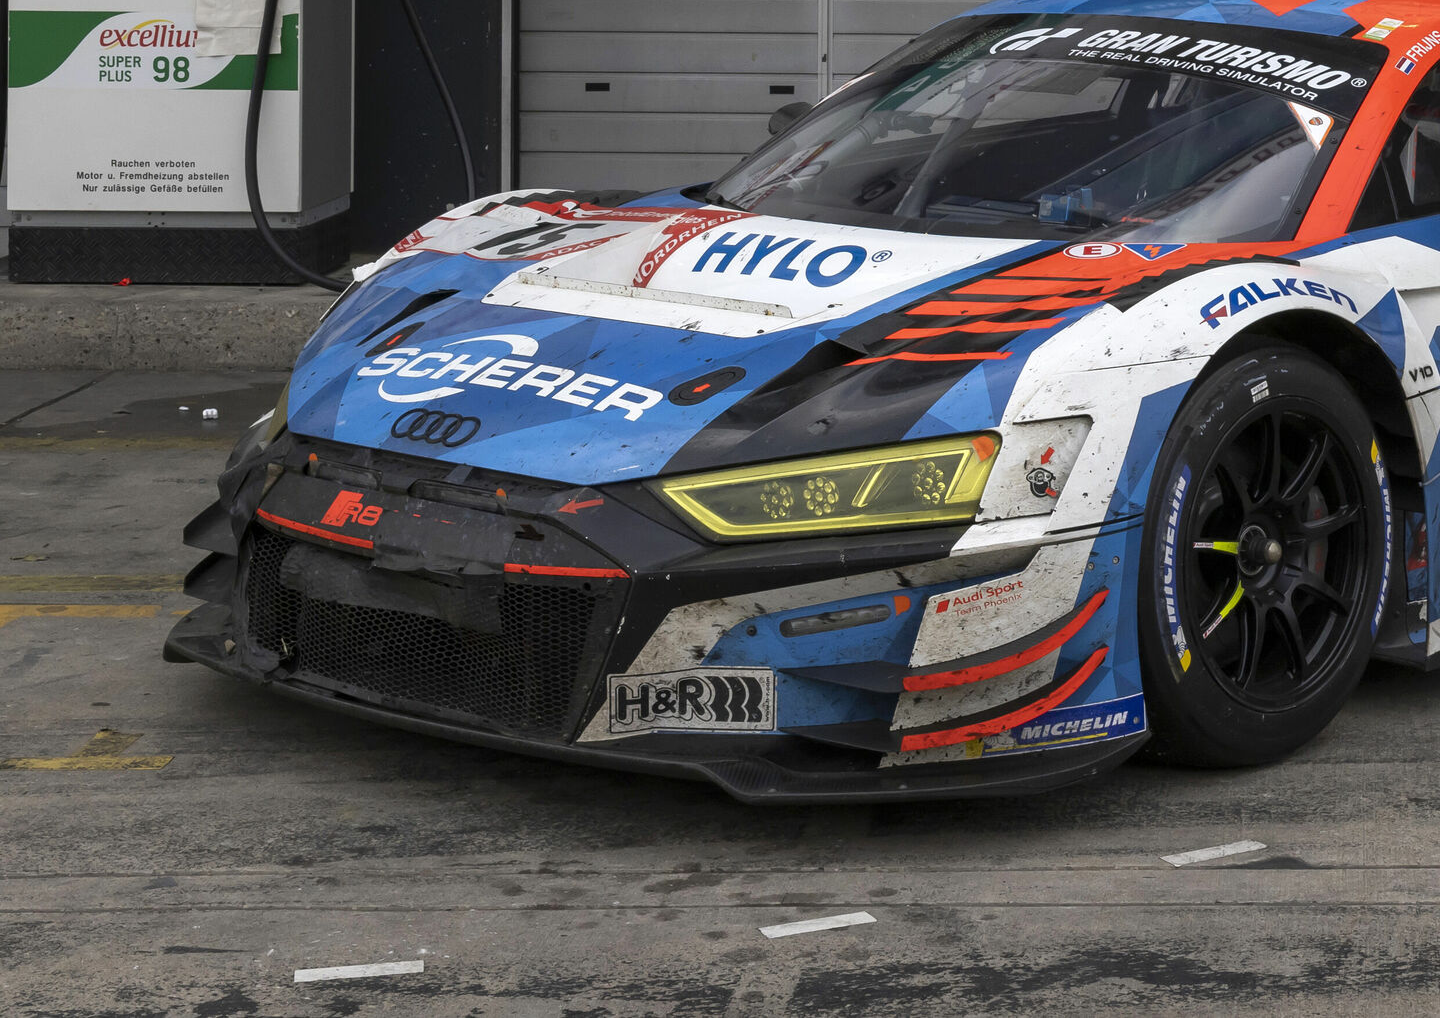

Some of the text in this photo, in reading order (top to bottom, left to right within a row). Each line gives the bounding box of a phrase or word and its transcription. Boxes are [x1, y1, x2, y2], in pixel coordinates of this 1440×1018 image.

[1077, 29, 1190, 54] GRAN
[99, 56, 190, 82] SUPER 98
[99, 70, 132, 82] PLUS
[1068, 49, 1319, 101] THE REAL DRIVING SIMULATOR
[76, 171, 103, 180] Motor
[120, 172, 184, 182] Fremdheizung
[188, 173, 230, 181] abstellen
[111, 159, 196, 168] Rauchen verboten
[82, 184, 224, 195] Nur zulässige Gefäße befüllen
[541, 239, 600, 259] ADAC
[1200, 278, 1359, 329] FALKEN
[357, 348, 664, 422] SCHERER
[1409, 366, 1434, 380] V10
[336, 501, 384, 527] R8
[1163, 475, 1188, 624] MICHELIN
[953, 580, 1024, 606] Audi Sport
[955, 593, 1022, 616] Team Phoenix
[616, 676, 710, 722] H&R
[1021, 710, 1129, 741] MICHELIN
